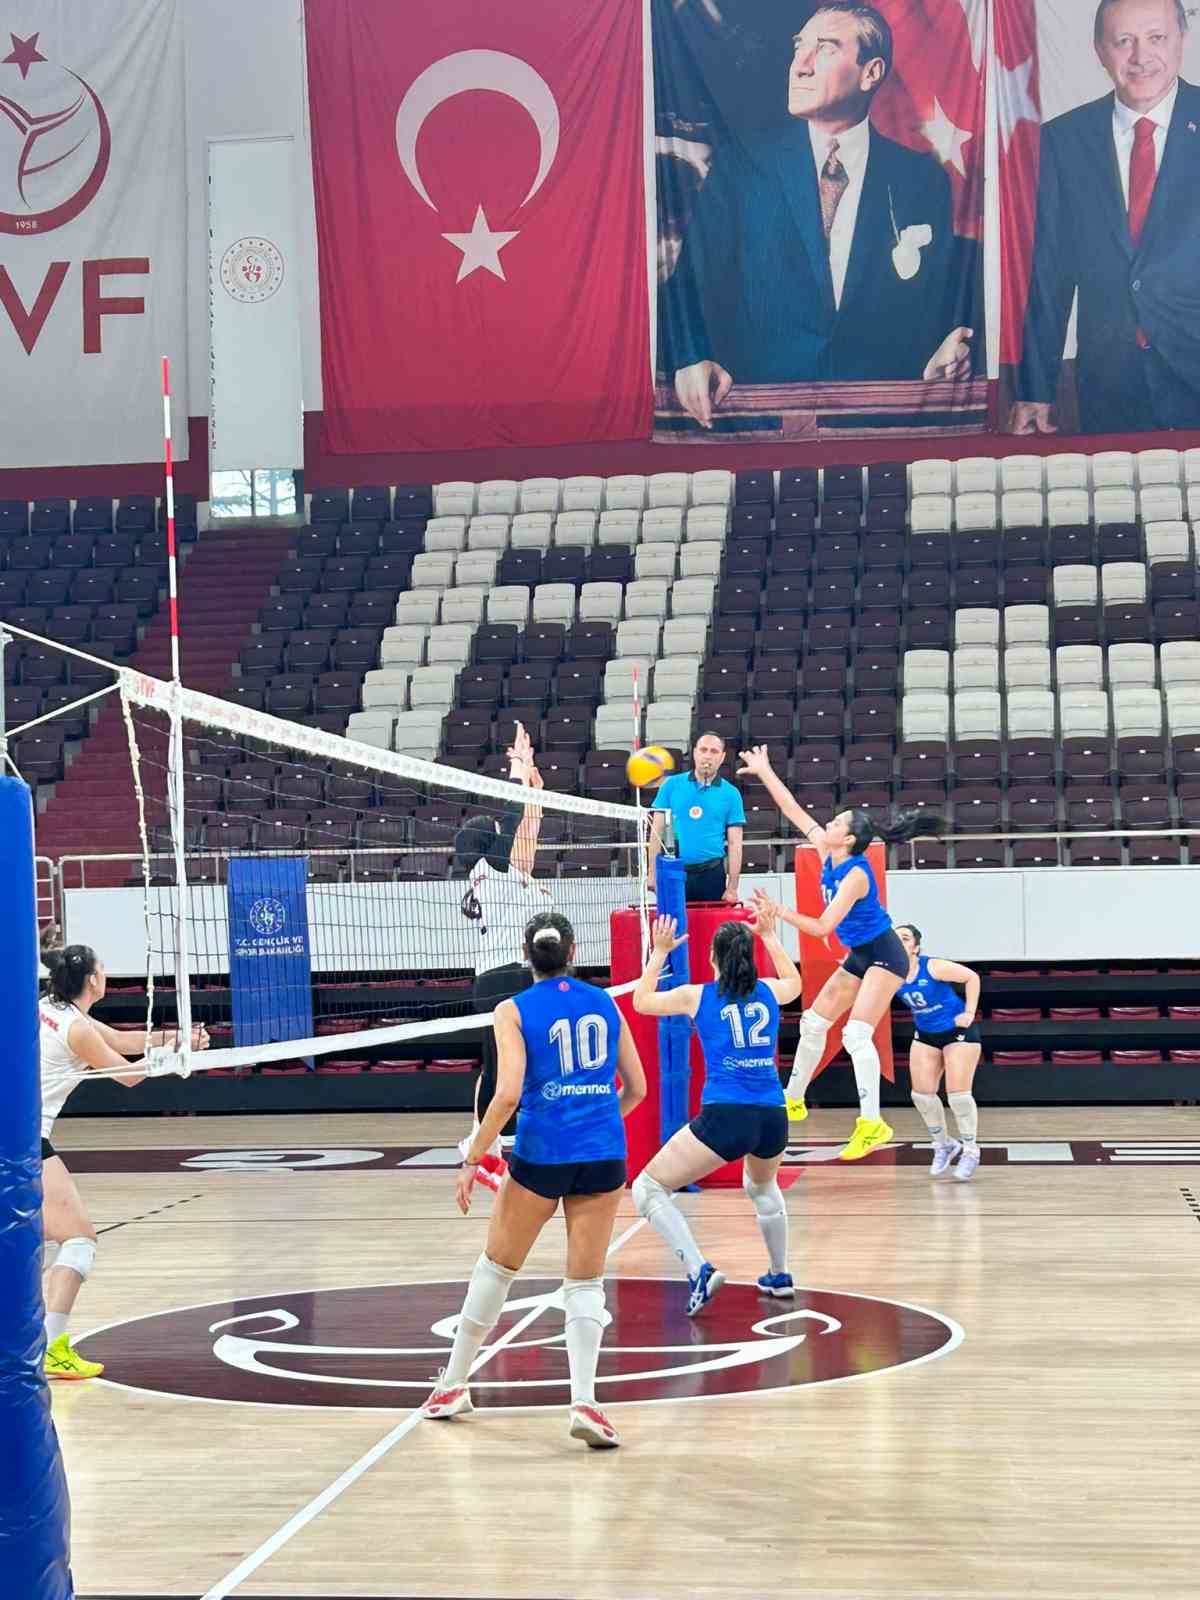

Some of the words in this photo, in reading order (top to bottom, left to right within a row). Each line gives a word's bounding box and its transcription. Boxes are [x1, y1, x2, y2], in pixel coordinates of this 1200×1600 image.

[292, 936, 304, 944] VE
[904, 991, 928, 1008] 13
[720, 1001, 771, 1049] 12
[549, 1013, 609, 1077] 10
